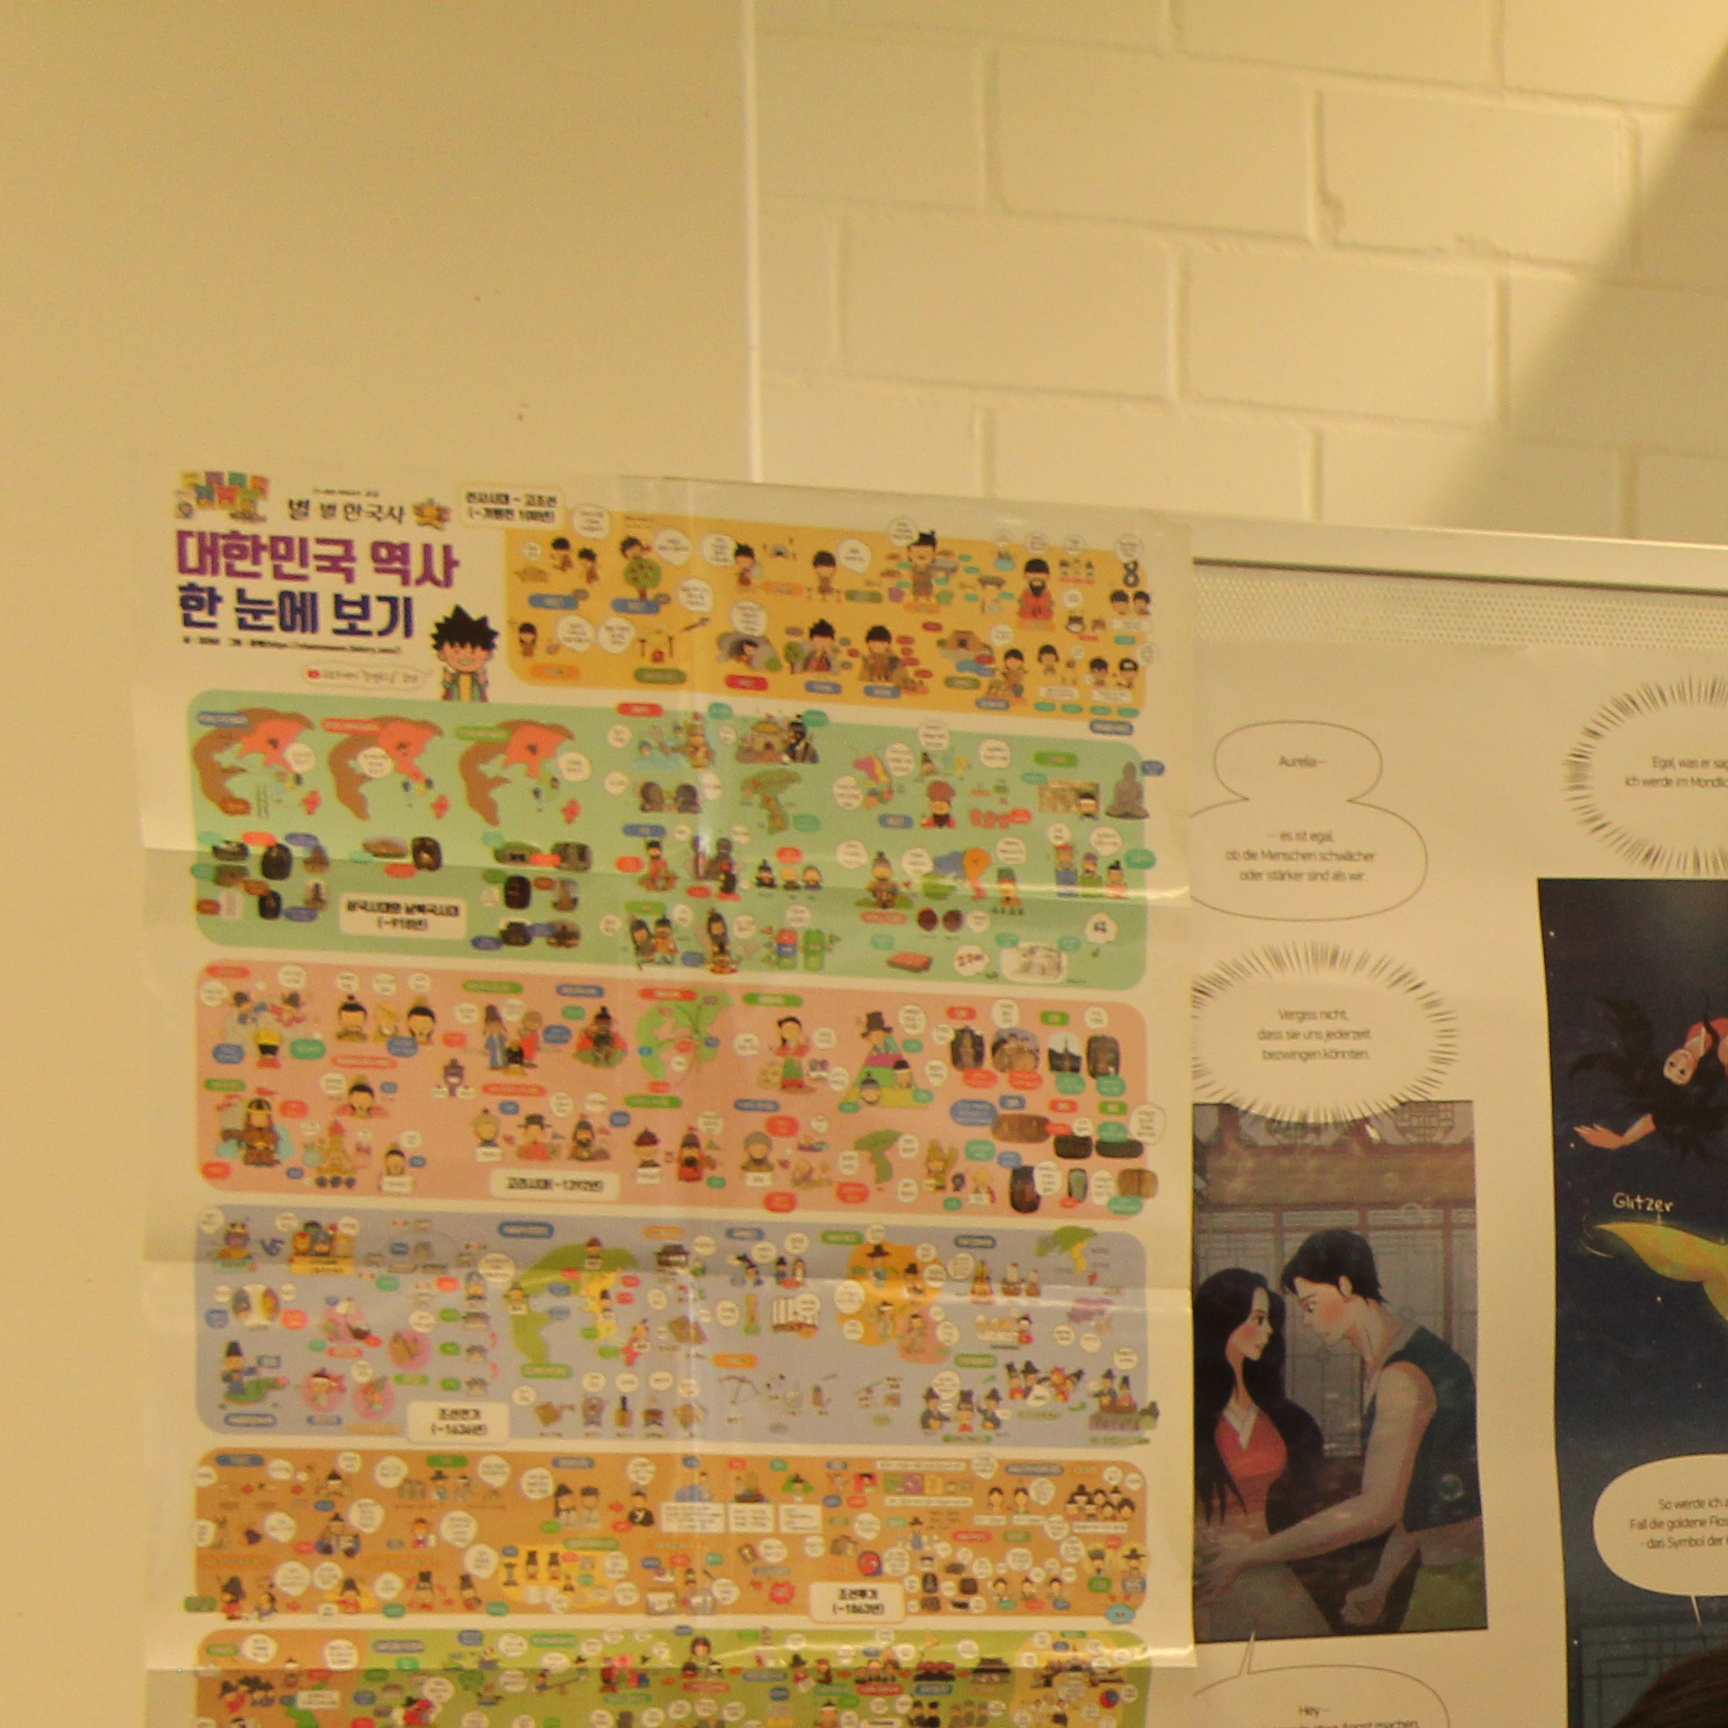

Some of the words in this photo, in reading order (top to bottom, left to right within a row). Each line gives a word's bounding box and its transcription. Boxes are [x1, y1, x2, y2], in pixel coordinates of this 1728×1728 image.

[177, 530, 357, 584] 대한민국
[371, 541, 460, 588] 역사
[179, 583, 224, 628] 한
[235, 588, 319, 634] 눈에
[333, 592, 414, 638] 보기
[1613, 1192, 1674, 1213] Glitzer
[1659, 1499, 1671, 1510] So
[1674, 1498, 1705, 1509] werde
[1630, 1518, 1648, 1530] Fall
[1649, 1518, 1664, 1529] die
